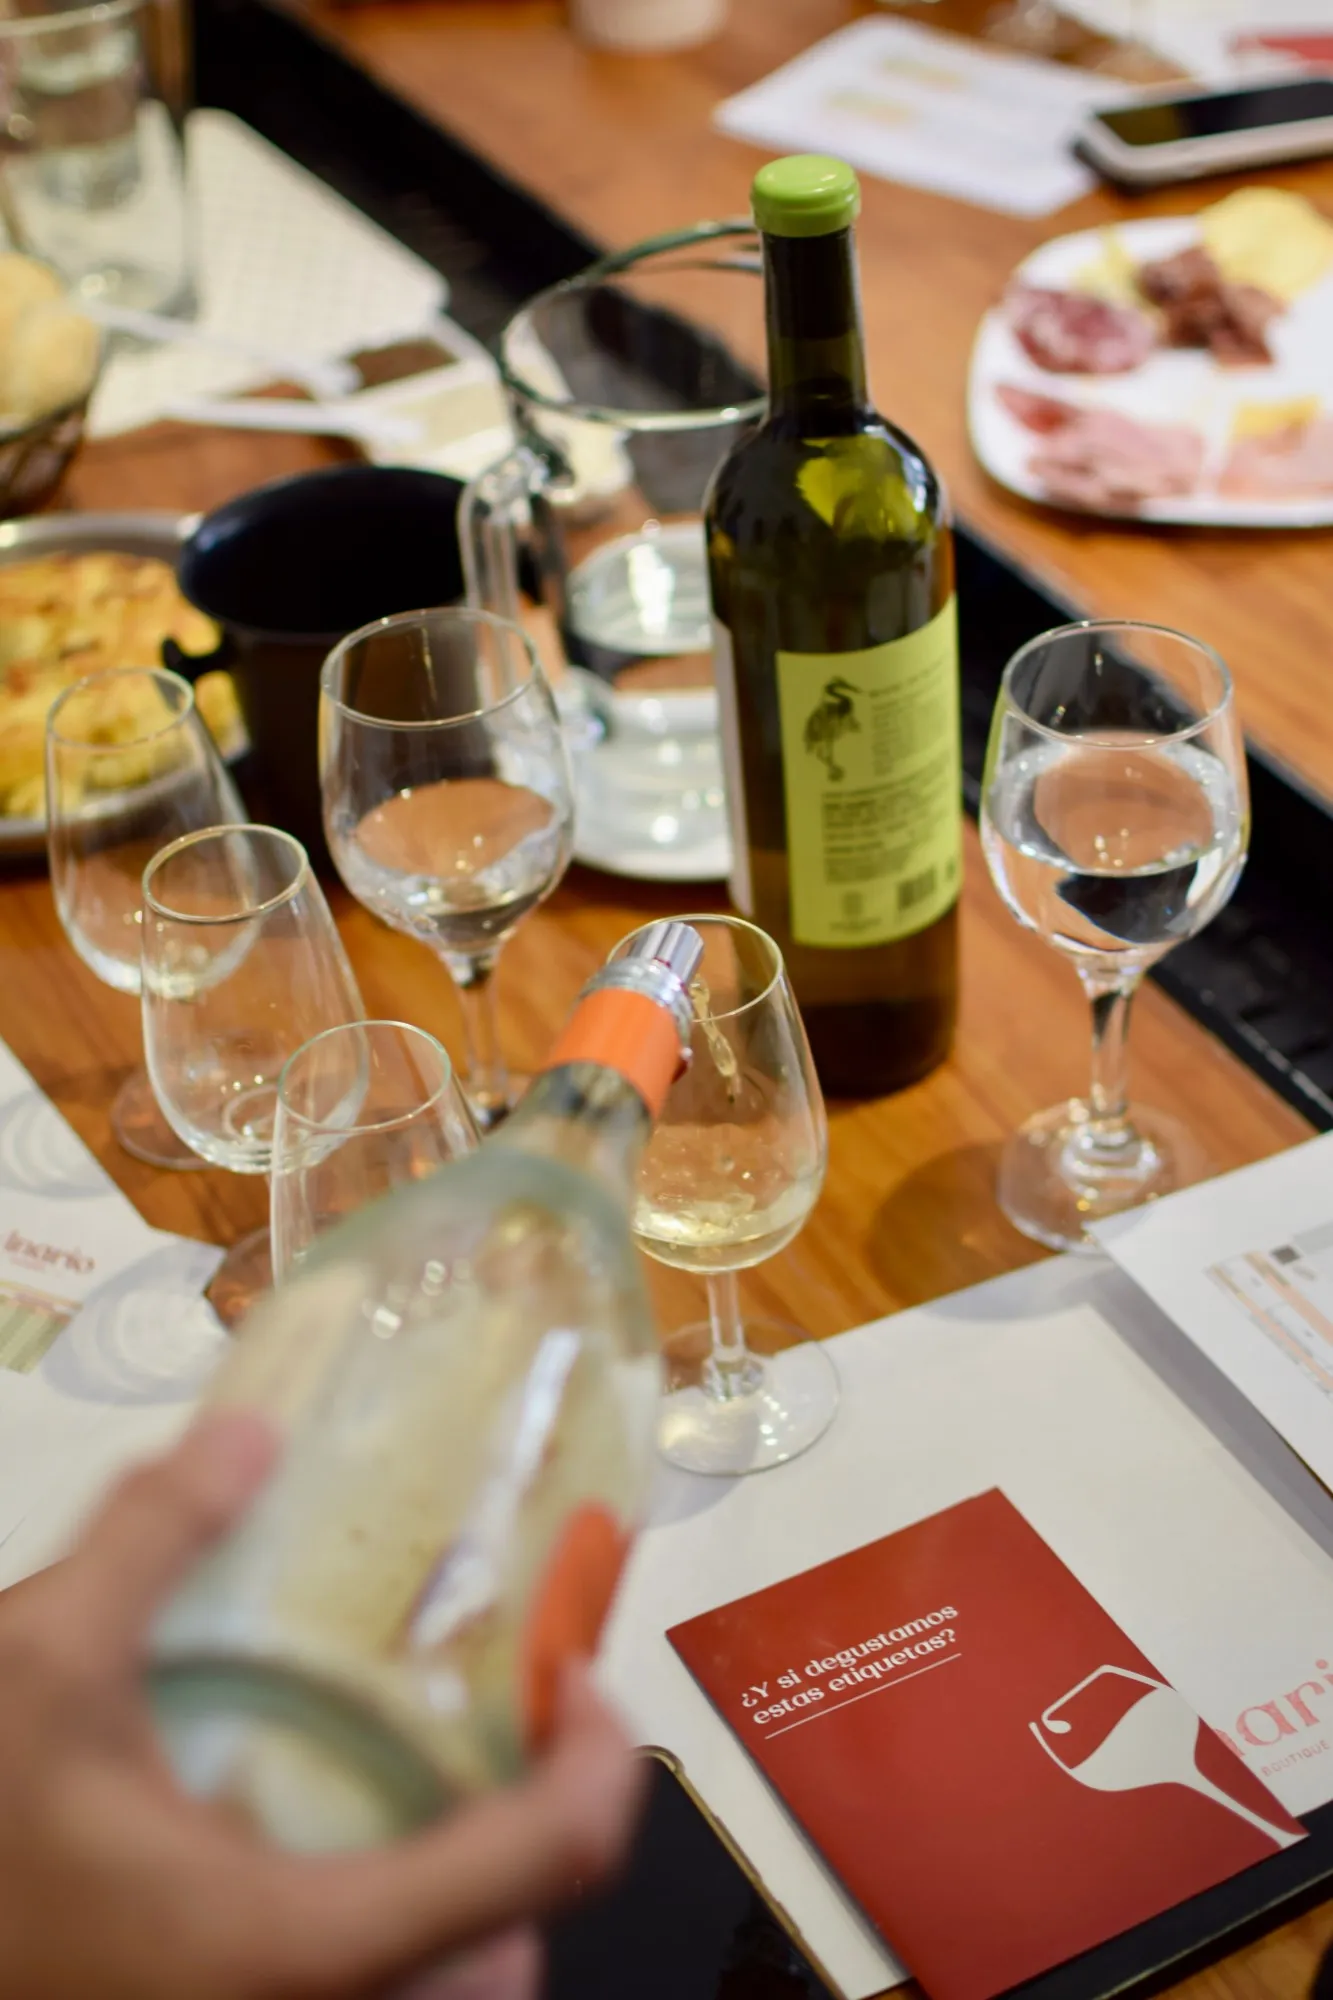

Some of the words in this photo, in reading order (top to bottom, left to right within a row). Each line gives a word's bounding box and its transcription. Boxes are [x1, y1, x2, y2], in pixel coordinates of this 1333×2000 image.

[741, 1681, 769, 1708] ¿Y
[776, 1668, 802, 1689] si
[804, 1605, 959, 1677] degustamos
[753, 1686, 825, 1725] estas
[828, 1628, 956, 1692] etiquetas?
[1260, 1739, 1331, 1777] BOUTIQUE
